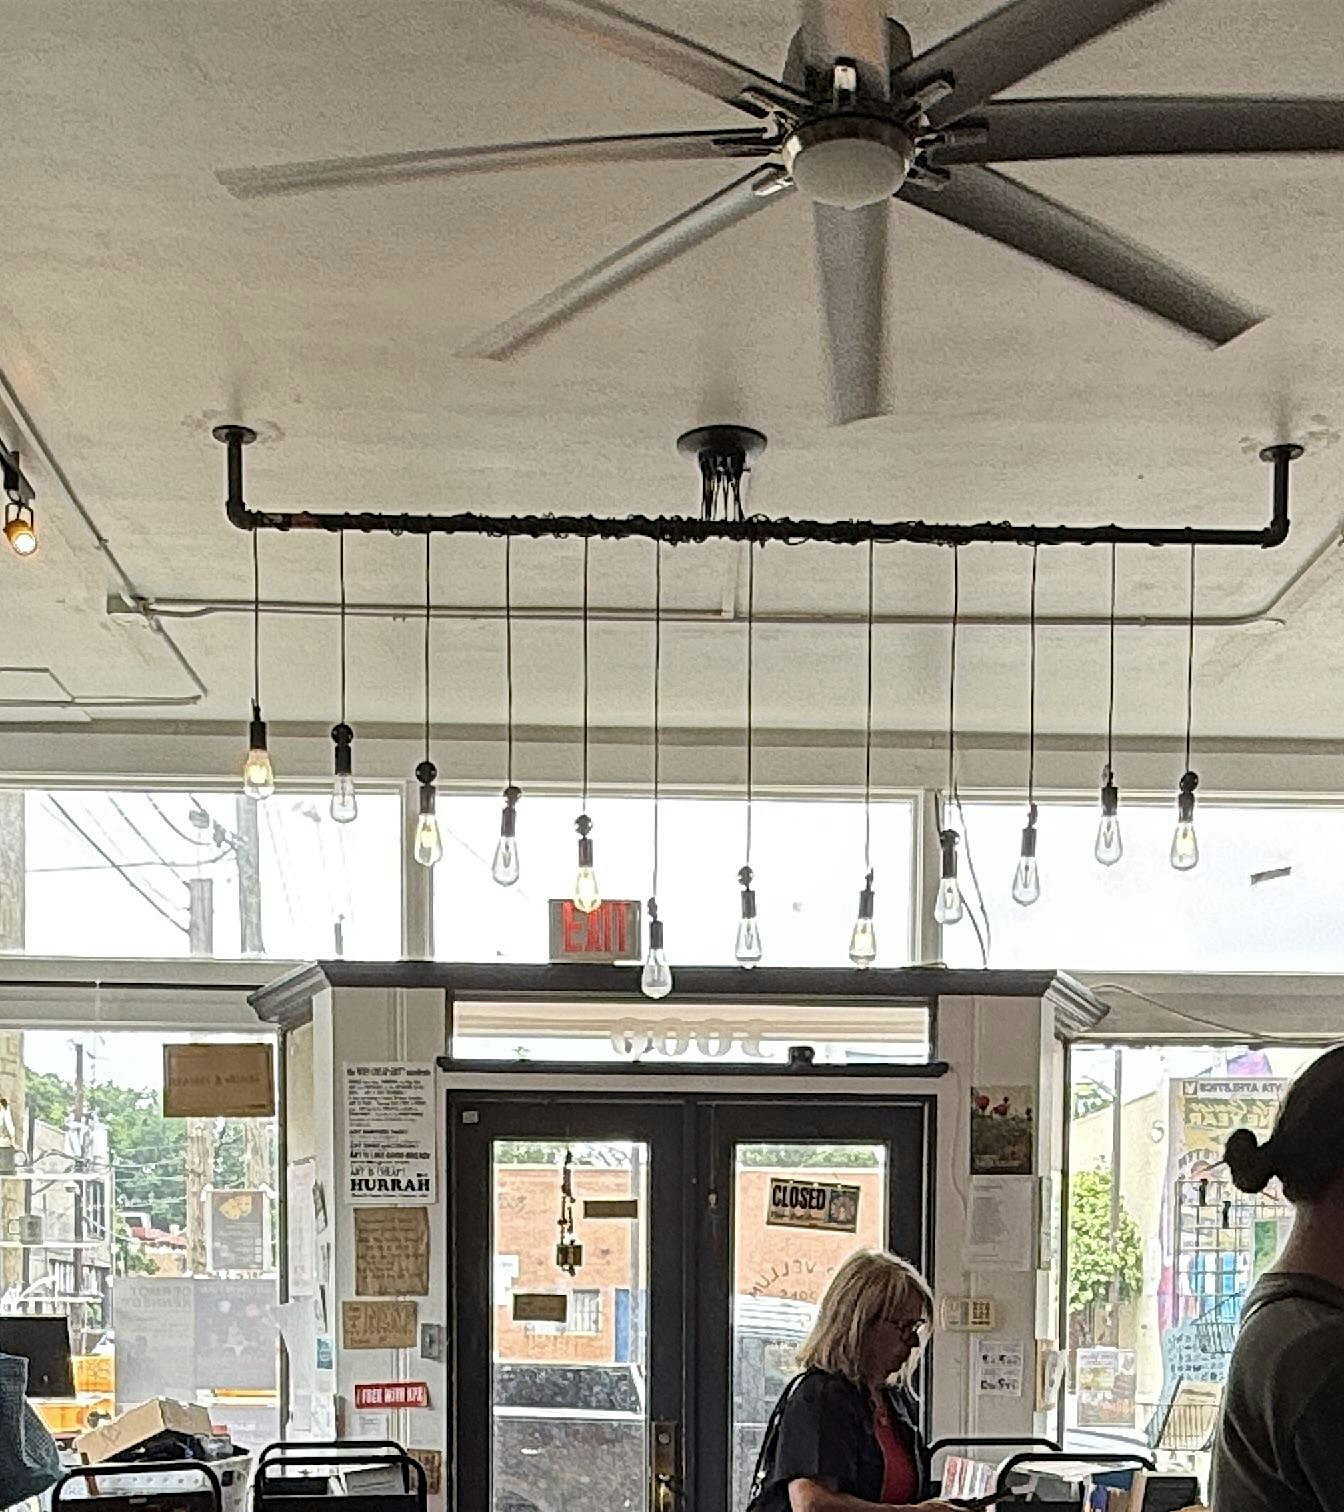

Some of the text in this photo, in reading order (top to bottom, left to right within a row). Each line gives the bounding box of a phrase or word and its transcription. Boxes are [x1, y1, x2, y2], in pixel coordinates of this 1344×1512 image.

[563, 900, 631, 953] EXIT
[350, 1178, 431, 1192] HURRAH
[772, 1184, 826, 1210] CLOSED
